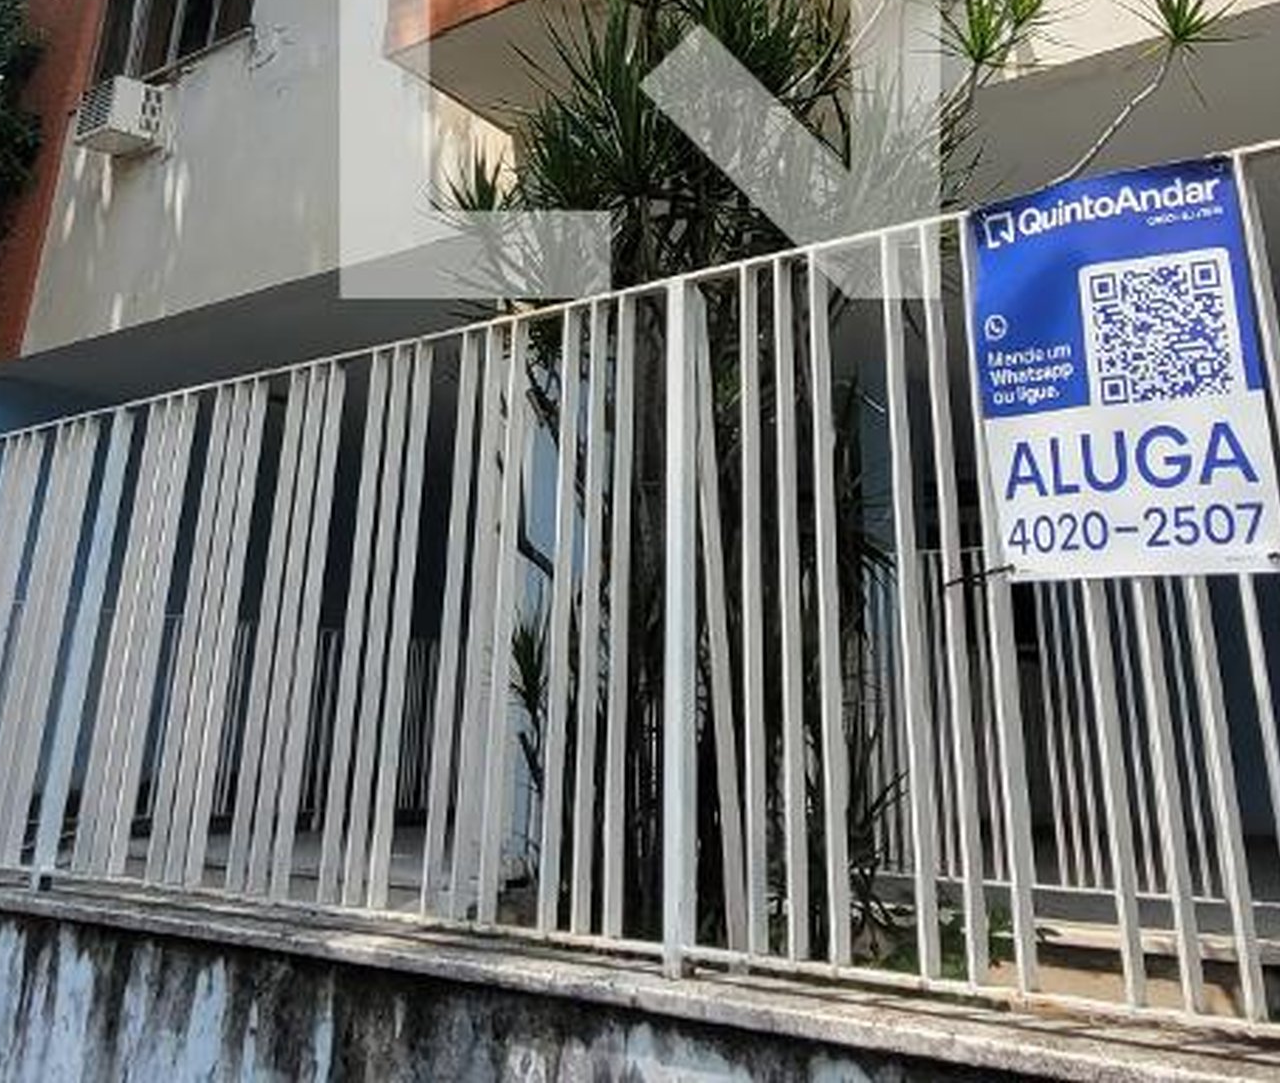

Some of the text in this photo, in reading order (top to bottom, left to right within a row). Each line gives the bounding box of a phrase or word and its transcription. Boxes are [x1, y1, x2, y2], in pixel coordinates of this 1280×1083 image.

[1017, 177, 1220, 237] QuintoAndar
[1047, 344, 1072, 359] um
[989, 362, 1074, 386] Whatsapp
[993, 391, 1015, 405] ou
[1005, 422, 1259, 500] ALUGA
[1008, 502, 1263, 555] 4020-2507
